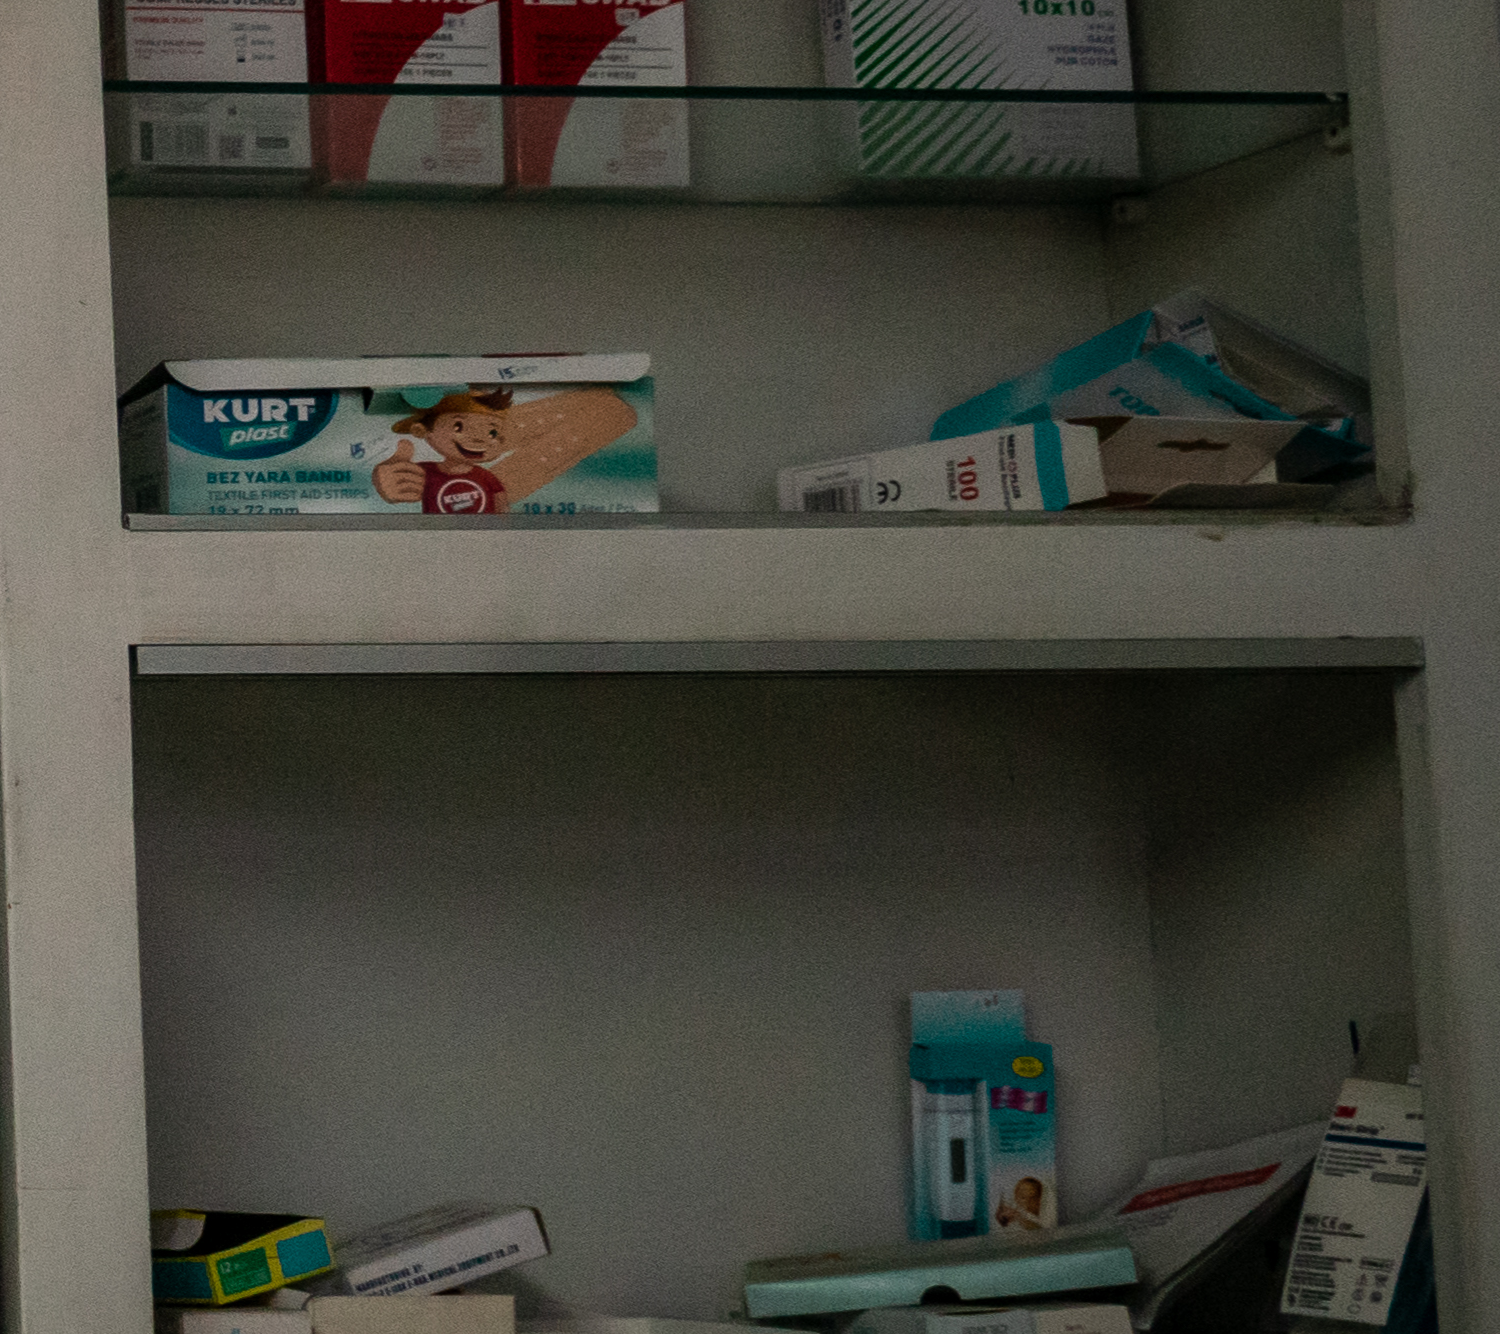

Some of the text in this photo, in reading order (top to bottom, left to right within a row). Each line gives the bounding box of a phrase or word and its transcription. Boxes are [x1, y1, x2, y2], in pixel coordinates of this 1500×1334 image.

[1019, 0, 1096, 16] 10x10
[203, 397, 315, 423] KURT
[228, 424, 289, 446] plast
[207, 471, 239, 484] BEZ
[244, 471, 291, 483] YARA
[957, 456, 979, 501] 100
